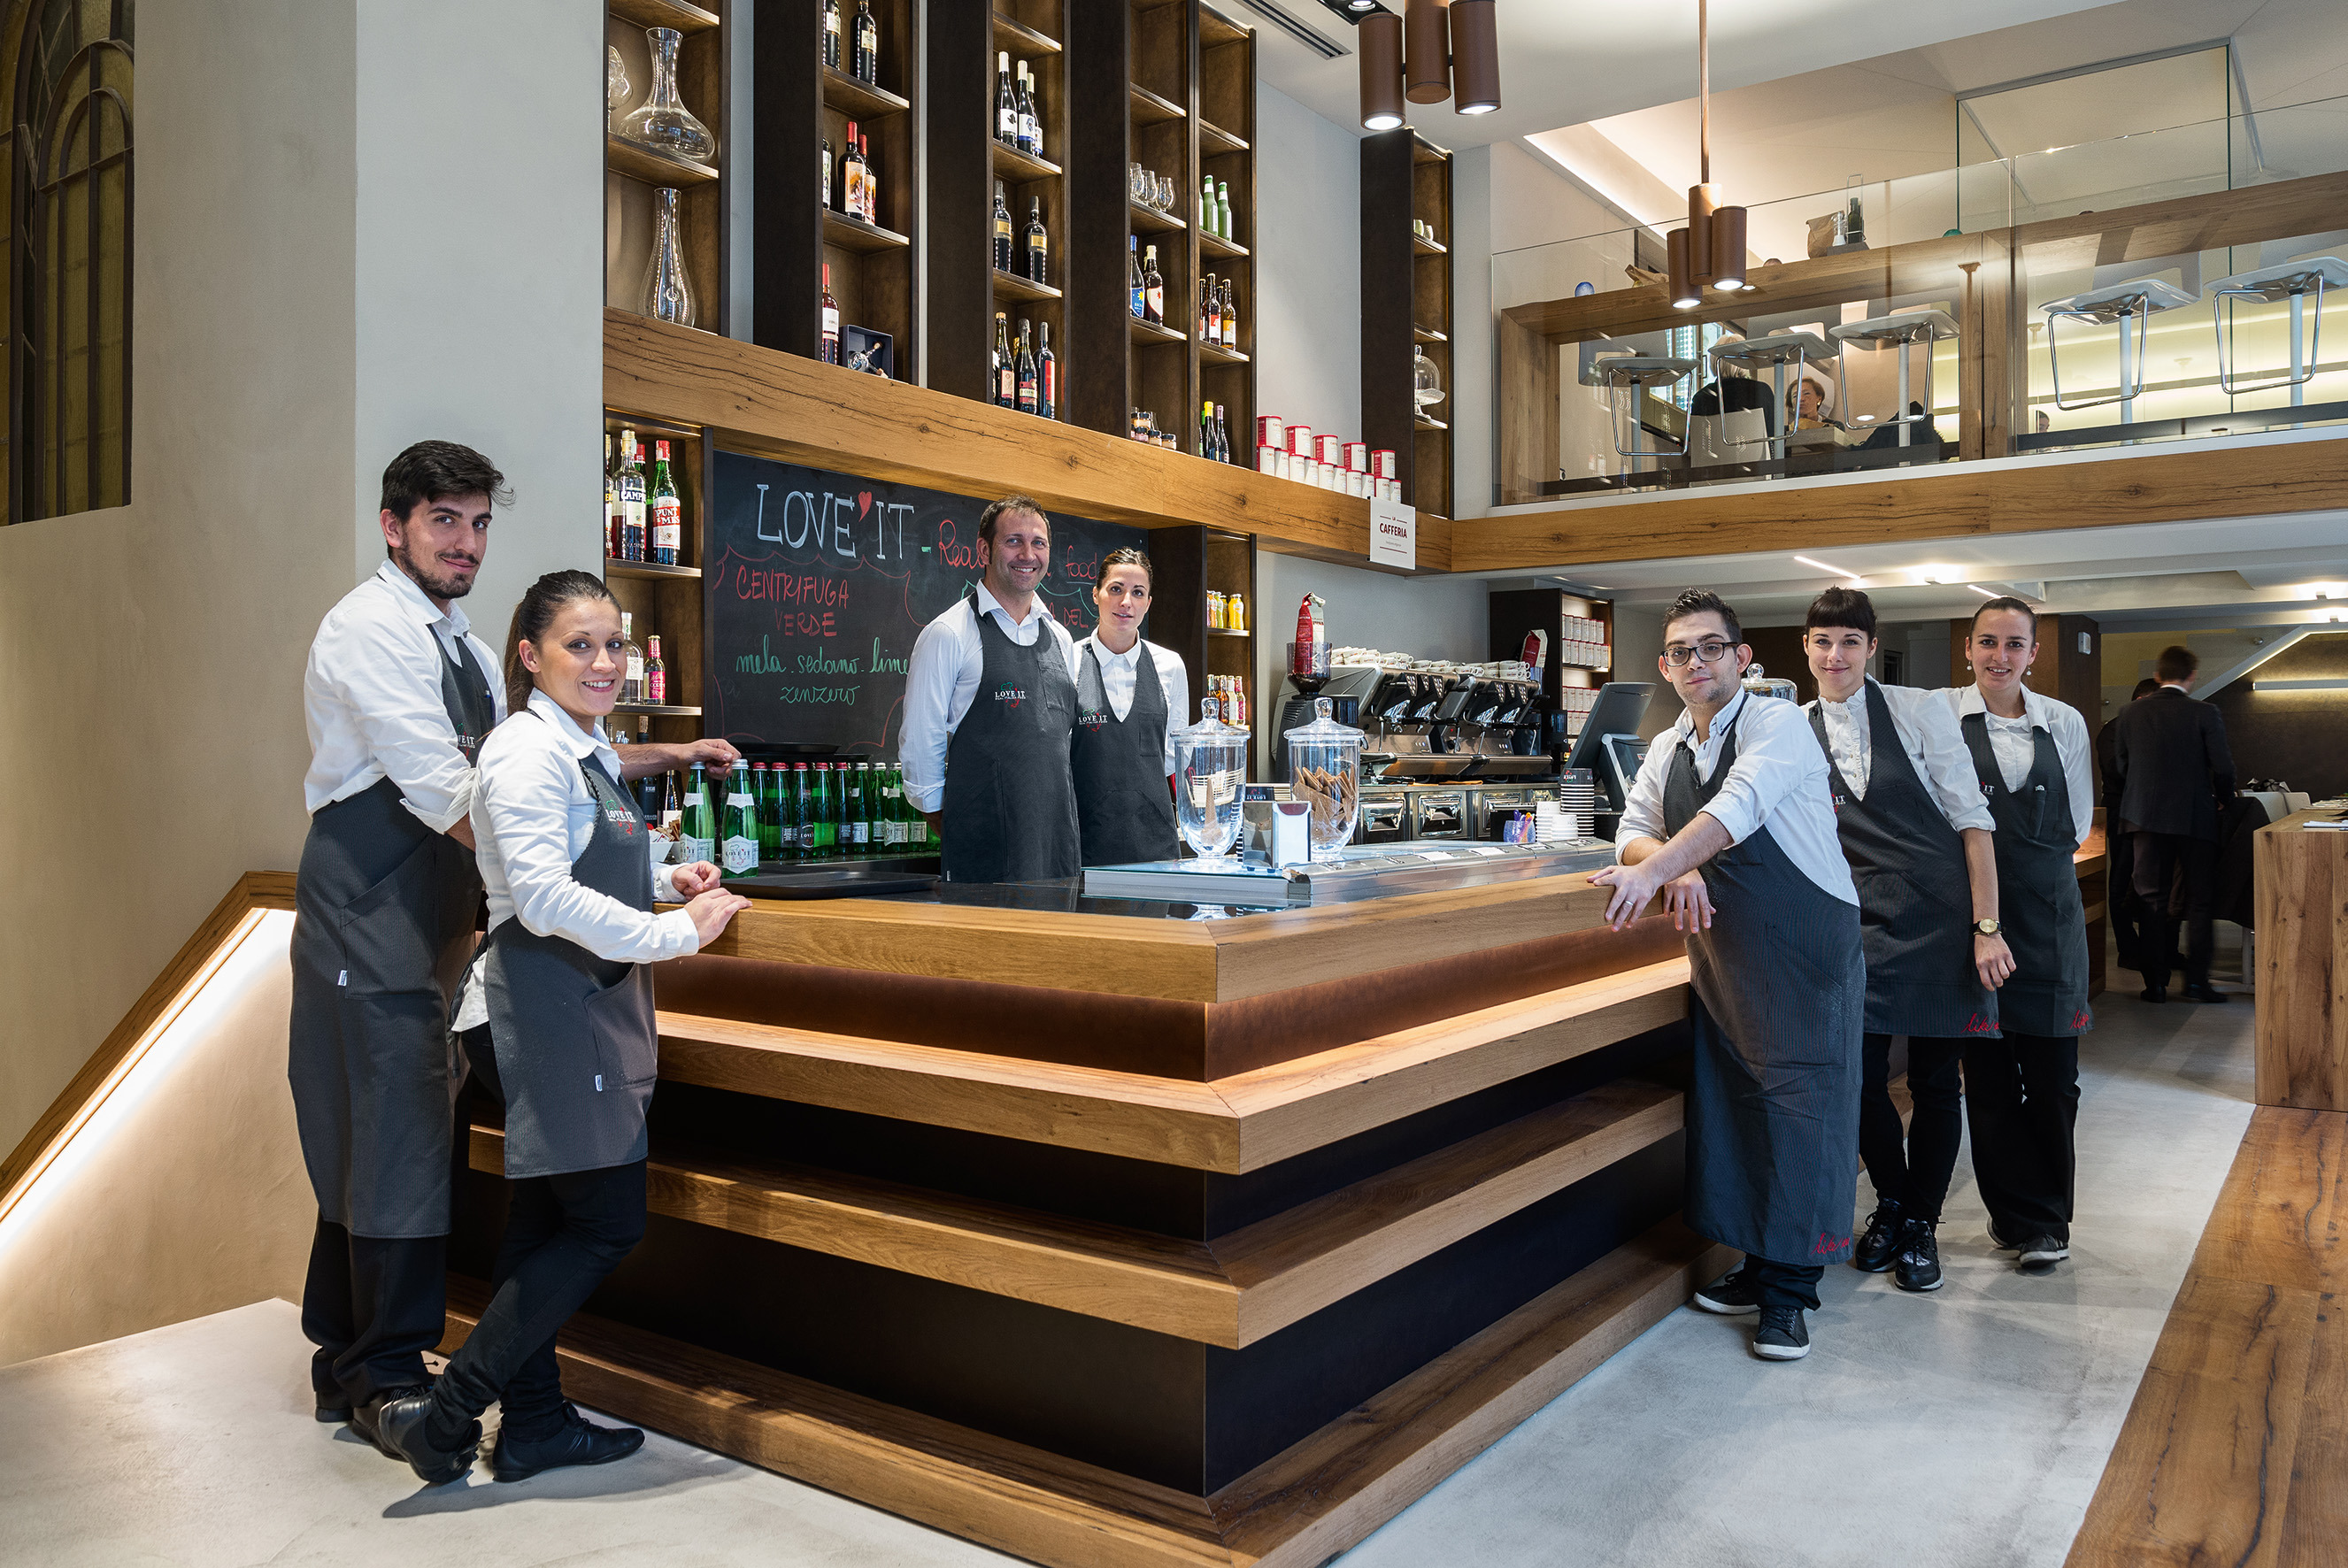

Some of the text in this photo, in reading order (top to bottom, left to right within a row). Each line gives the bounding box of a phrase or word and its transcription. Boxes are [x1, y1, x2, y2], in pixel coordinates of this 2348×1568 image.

[655, 507, 678, 518] PUNT
[1379, 522, 1408, 539] CAFFERIA
[1066, 545, 1097, 580] food
[736, 565, 850, 609] CENTRIFUGA
[774, 608, 837, 637] VERDE
[1064, 607, 1089, 628] DEL
[780, 685, 861, 706] zenzero
[605, 809, 625, 819] LOVE
